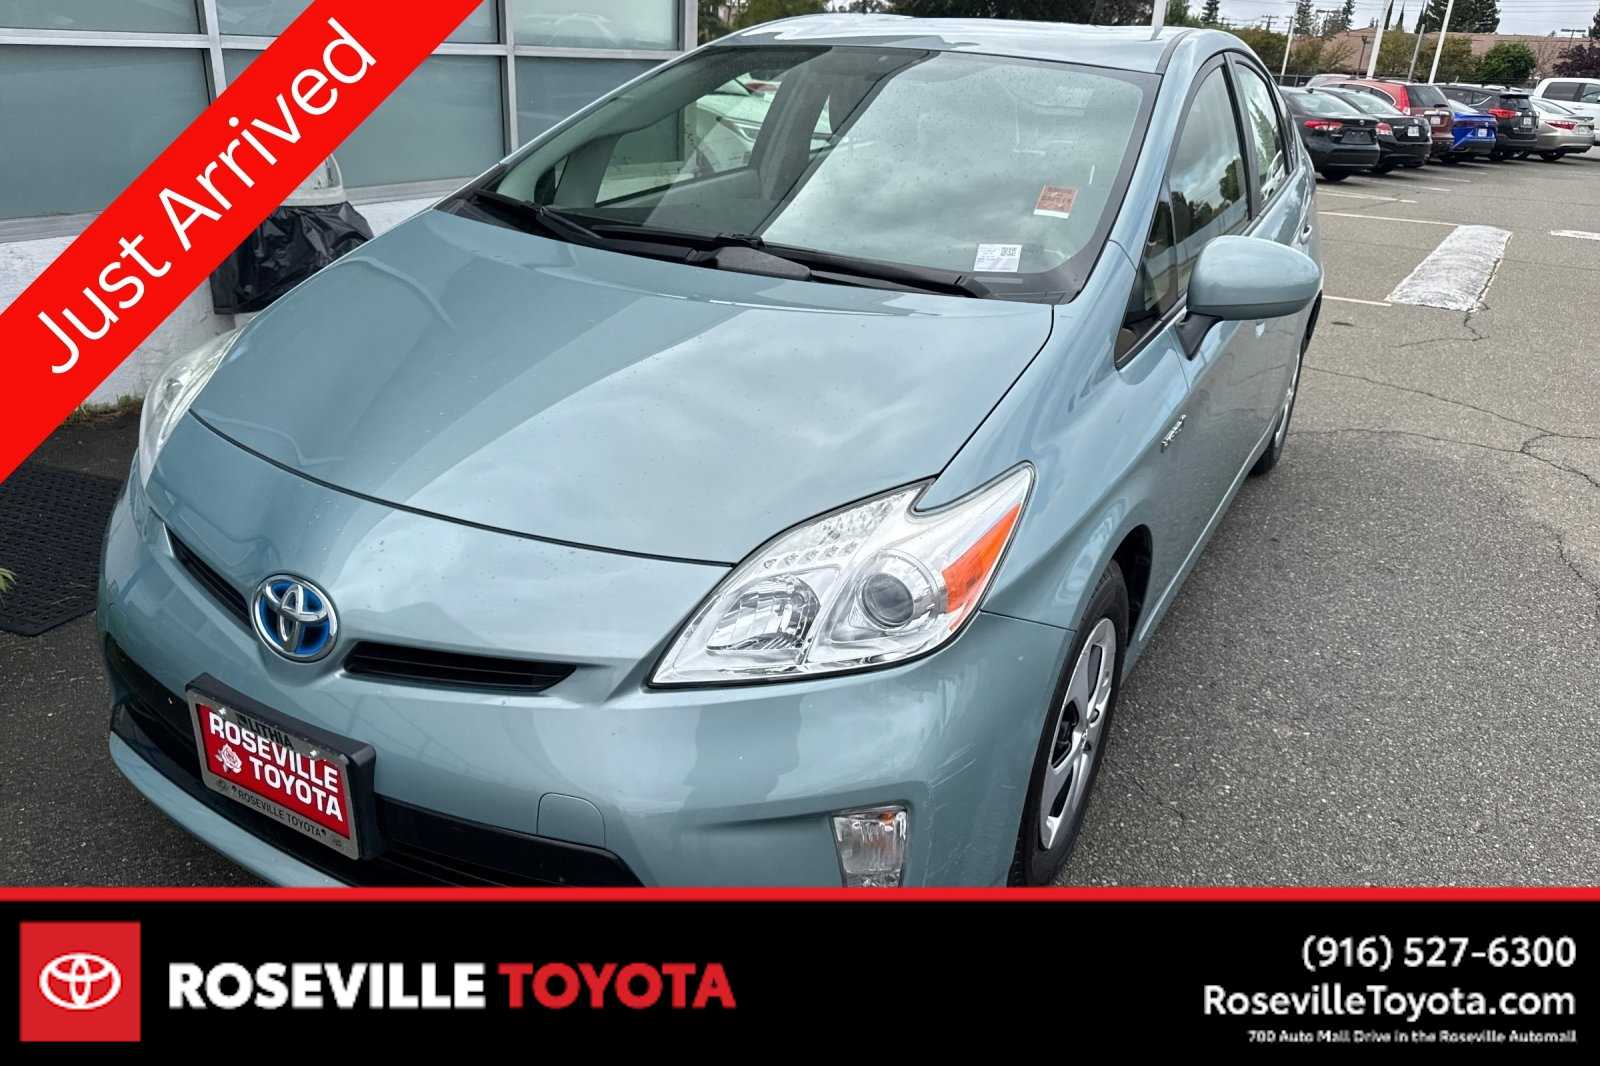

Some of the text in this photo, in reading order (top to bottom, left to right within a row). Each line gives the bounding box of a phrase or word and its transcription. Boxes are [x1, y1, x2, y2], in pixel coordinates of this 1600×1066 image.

[209, 711, 338, 794] ROSEVILLE
[238, 791, 321, 836] ROSEVILLE TOYOTA
[250, 756, 343, 822] TOYOTA
